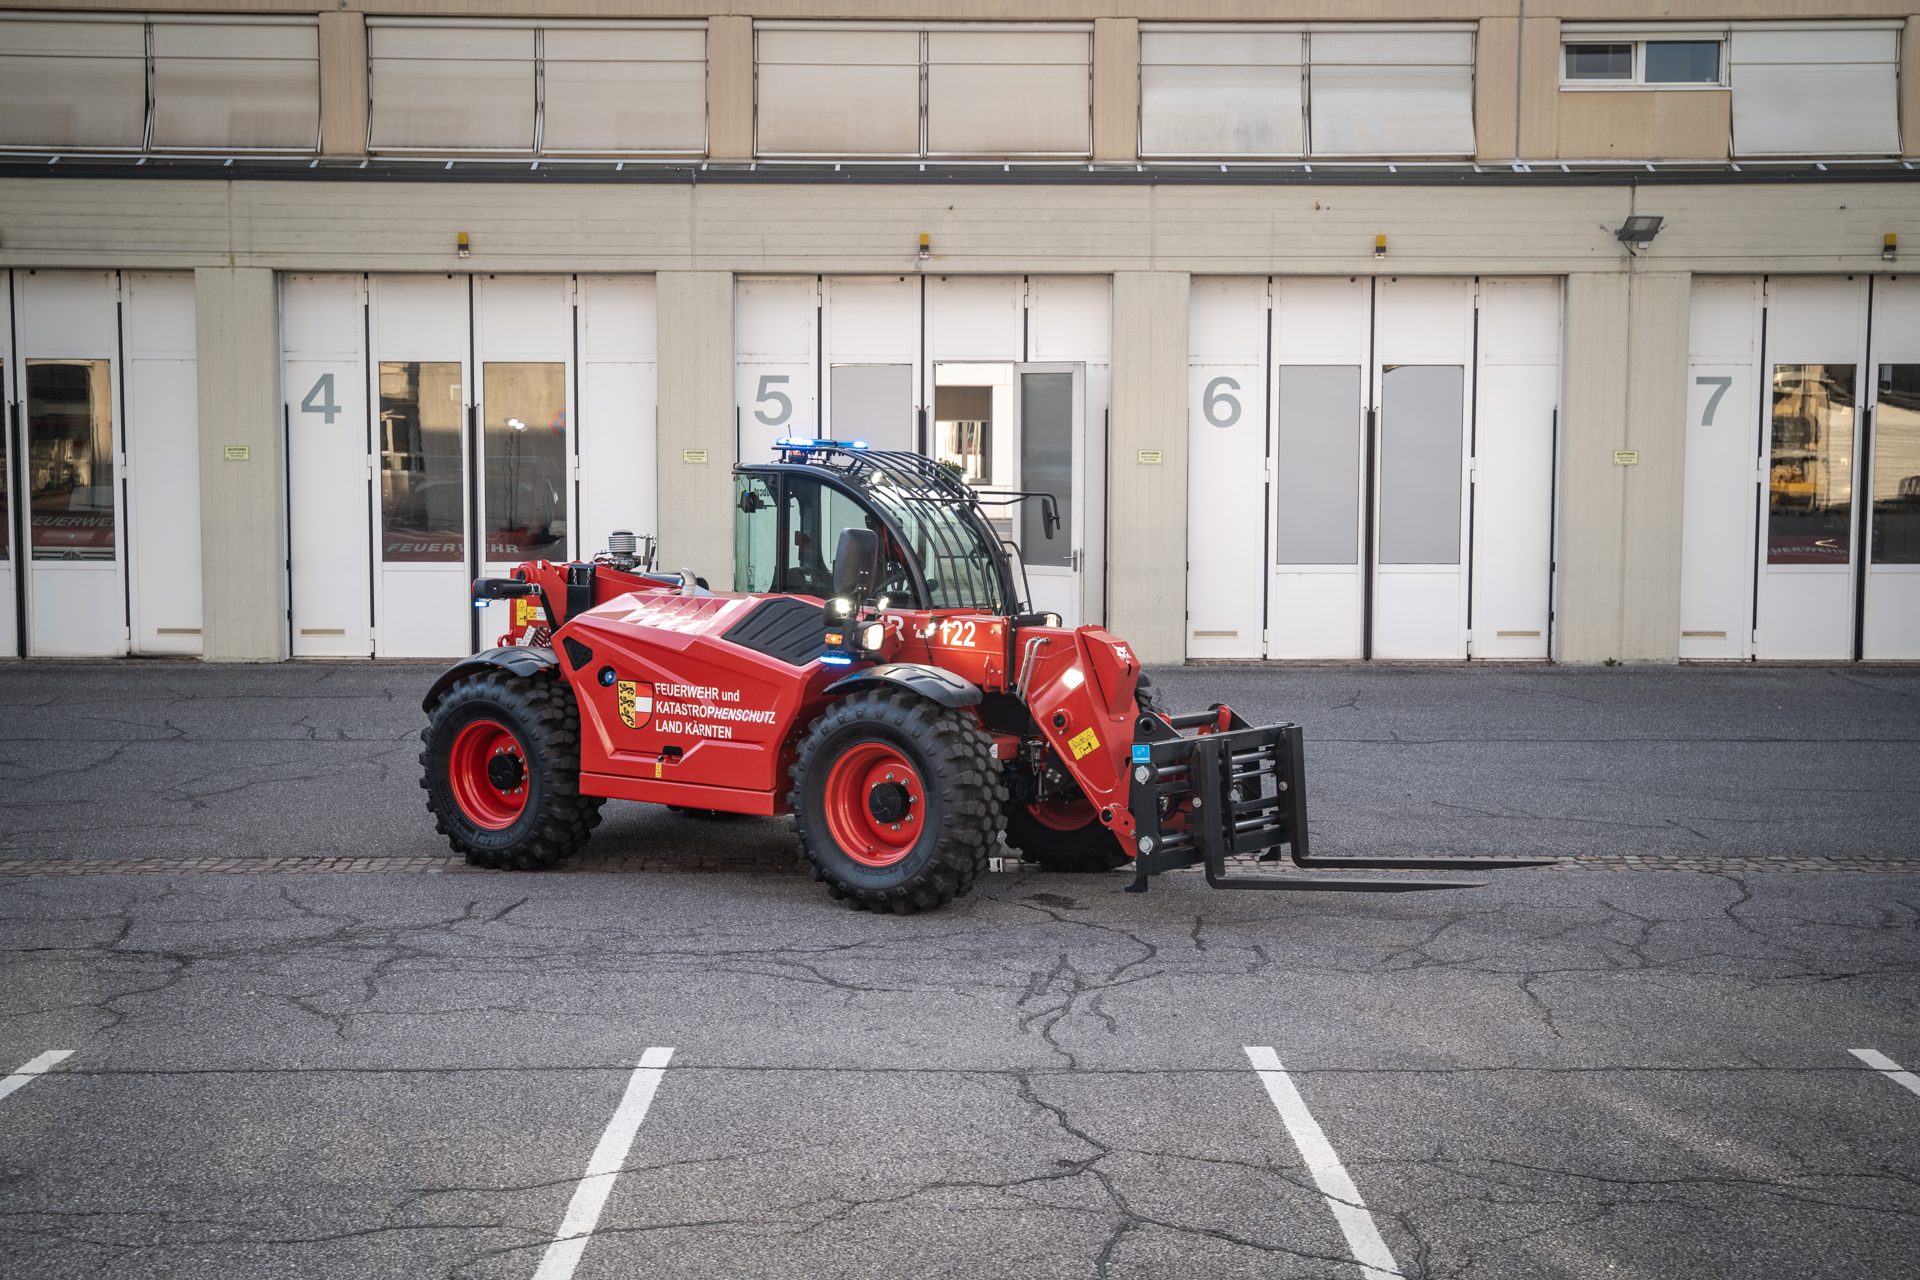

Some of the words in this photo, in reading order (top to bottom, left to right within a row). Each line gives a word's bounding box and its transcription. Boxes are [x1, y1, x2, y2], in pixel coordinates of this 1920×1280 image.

[301, 373, 342, 424] 4
[753, 375, 793, 426] 5
[1202, 376, 1242, 428] 6
[1695, 376, 1732, 426] 7
[32, 516, 115, 527] EUERWE
[388, 542, 519, 553] FEUERHR
[1770, 546, 1848, 555] UERWEHR
[940, 619, 976, 647] 122
[655, 682, 719, 700] FEUERWEHR
[721, 690, 740, 702] und
[656, 701, 776, 724] KATASTROPHENSCHUTZ
[655, 720, 682, 734] LAND
[685, 720, 732, 739] KÄRNTEN
